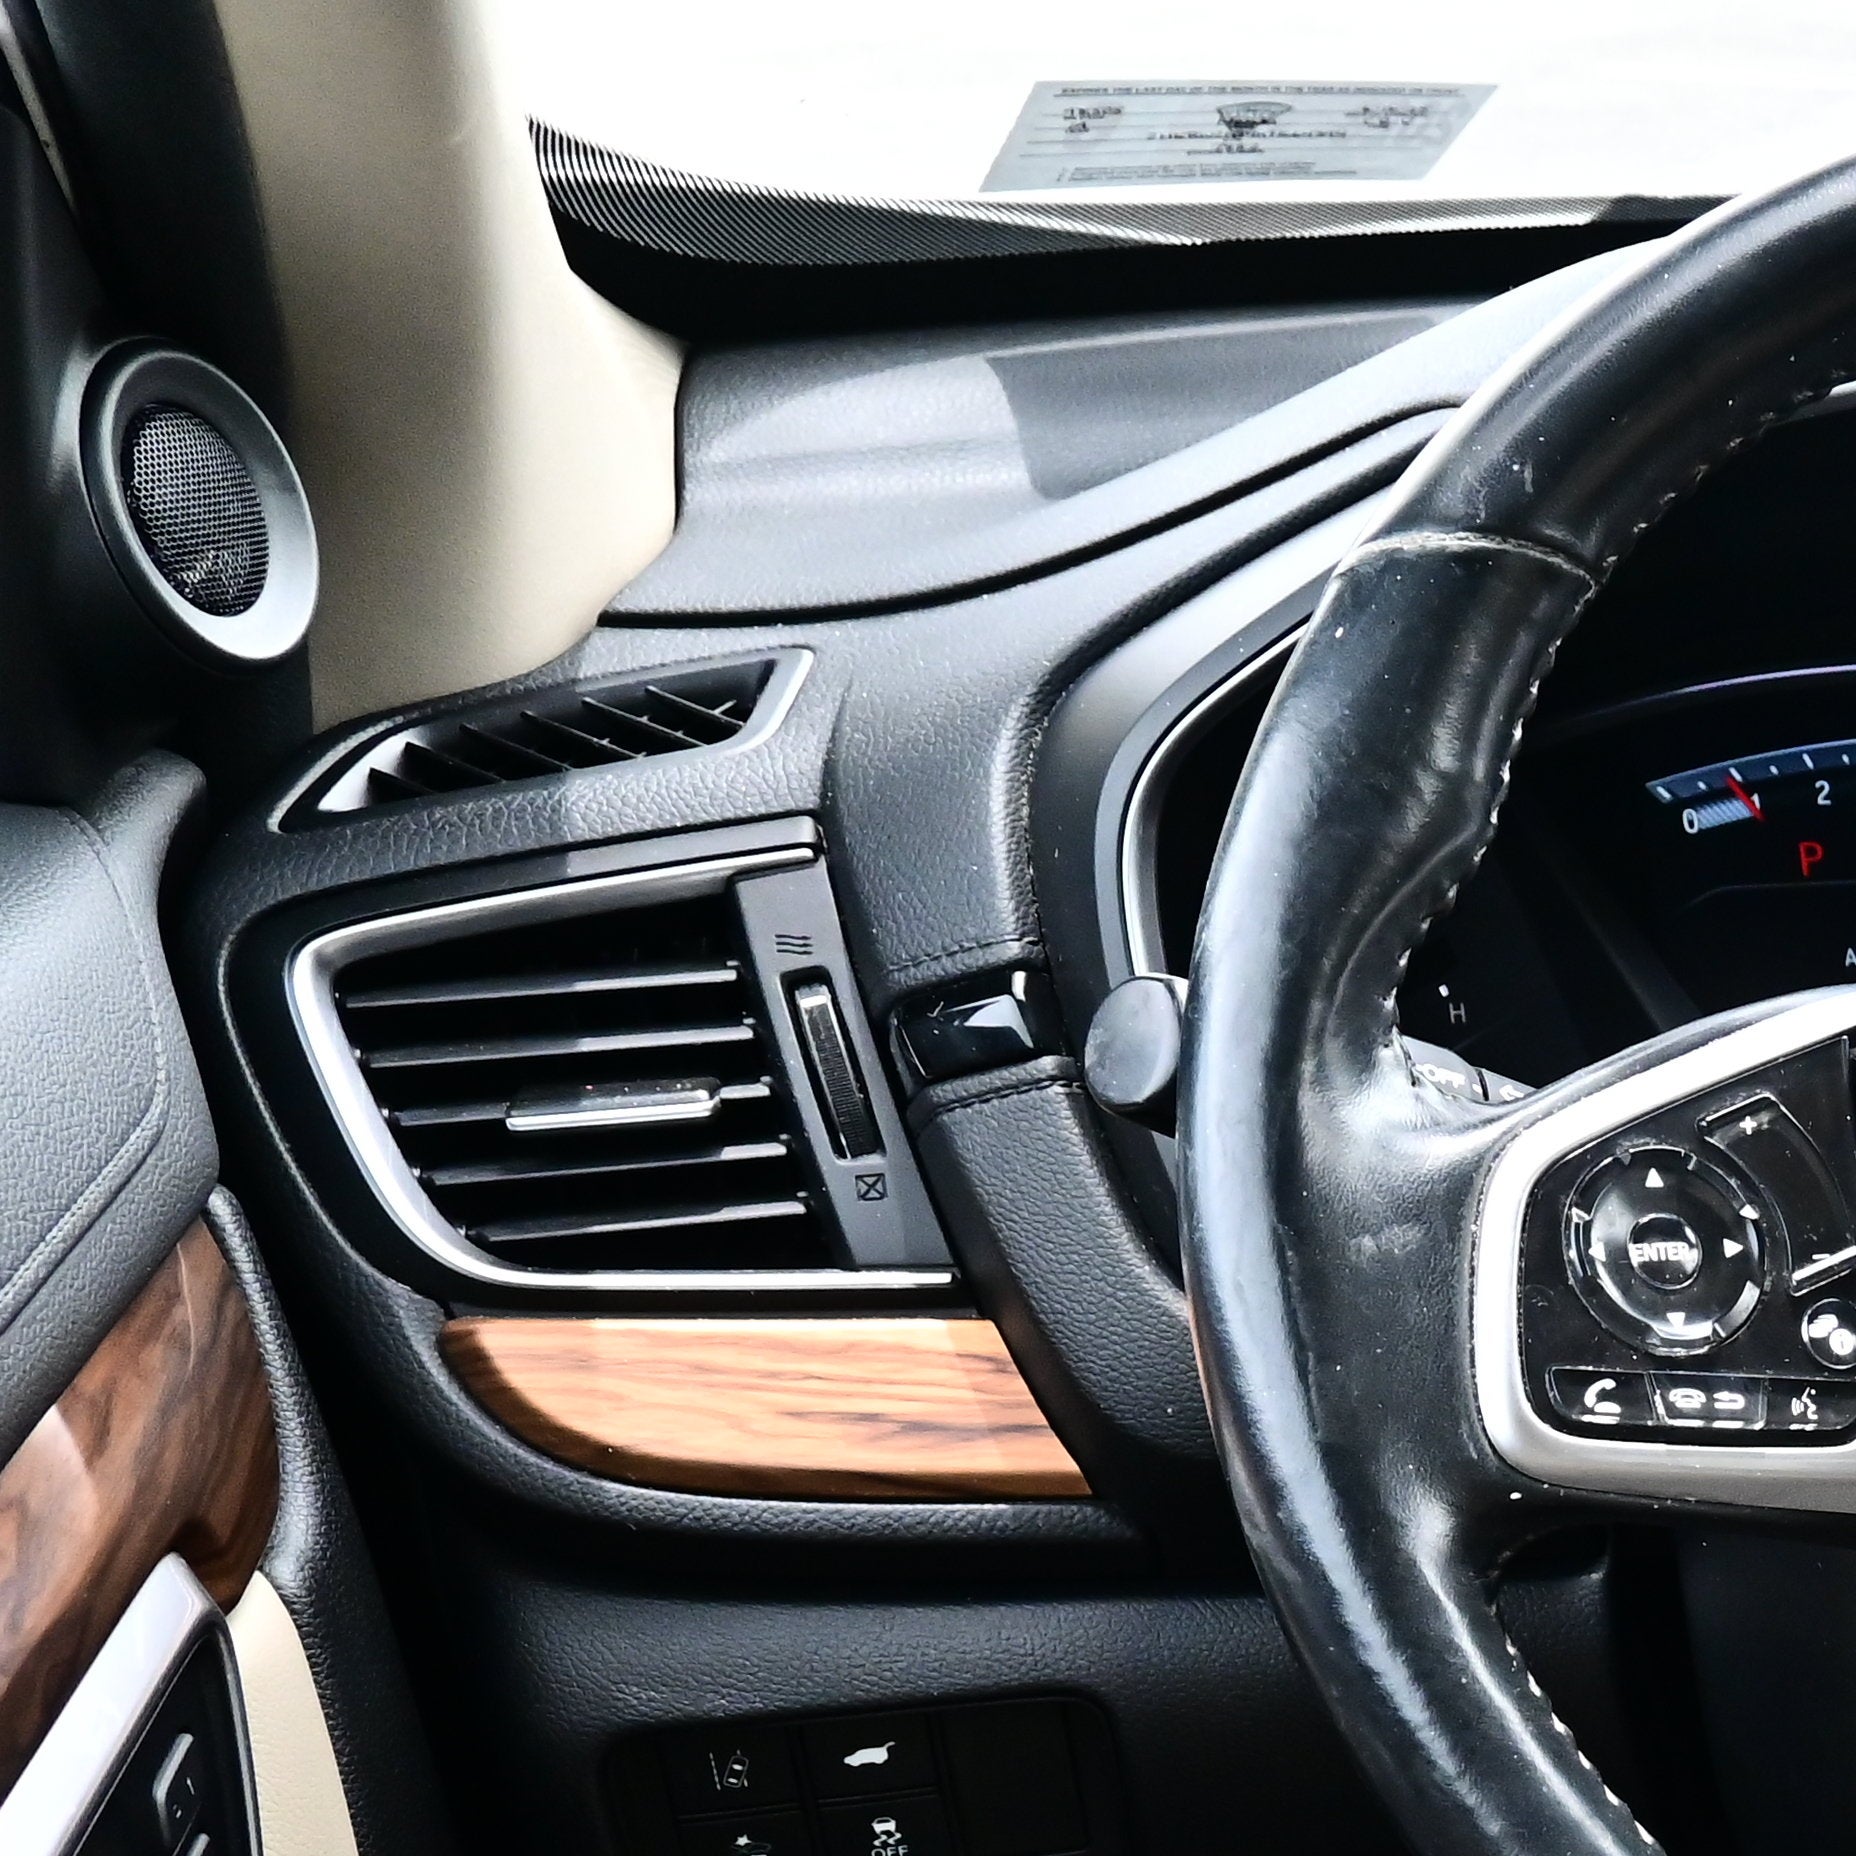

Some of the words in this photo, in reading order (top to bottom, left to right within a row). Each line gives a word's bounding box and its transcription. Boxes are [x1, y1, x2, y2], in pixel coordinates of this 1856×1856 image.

[1815, 780, 1831, 806] 2
[1682, 808, 1699, 834] 0
[1799, 841, 1824, 877] P
[1630, 1241, 1691, 1263] ENTER
